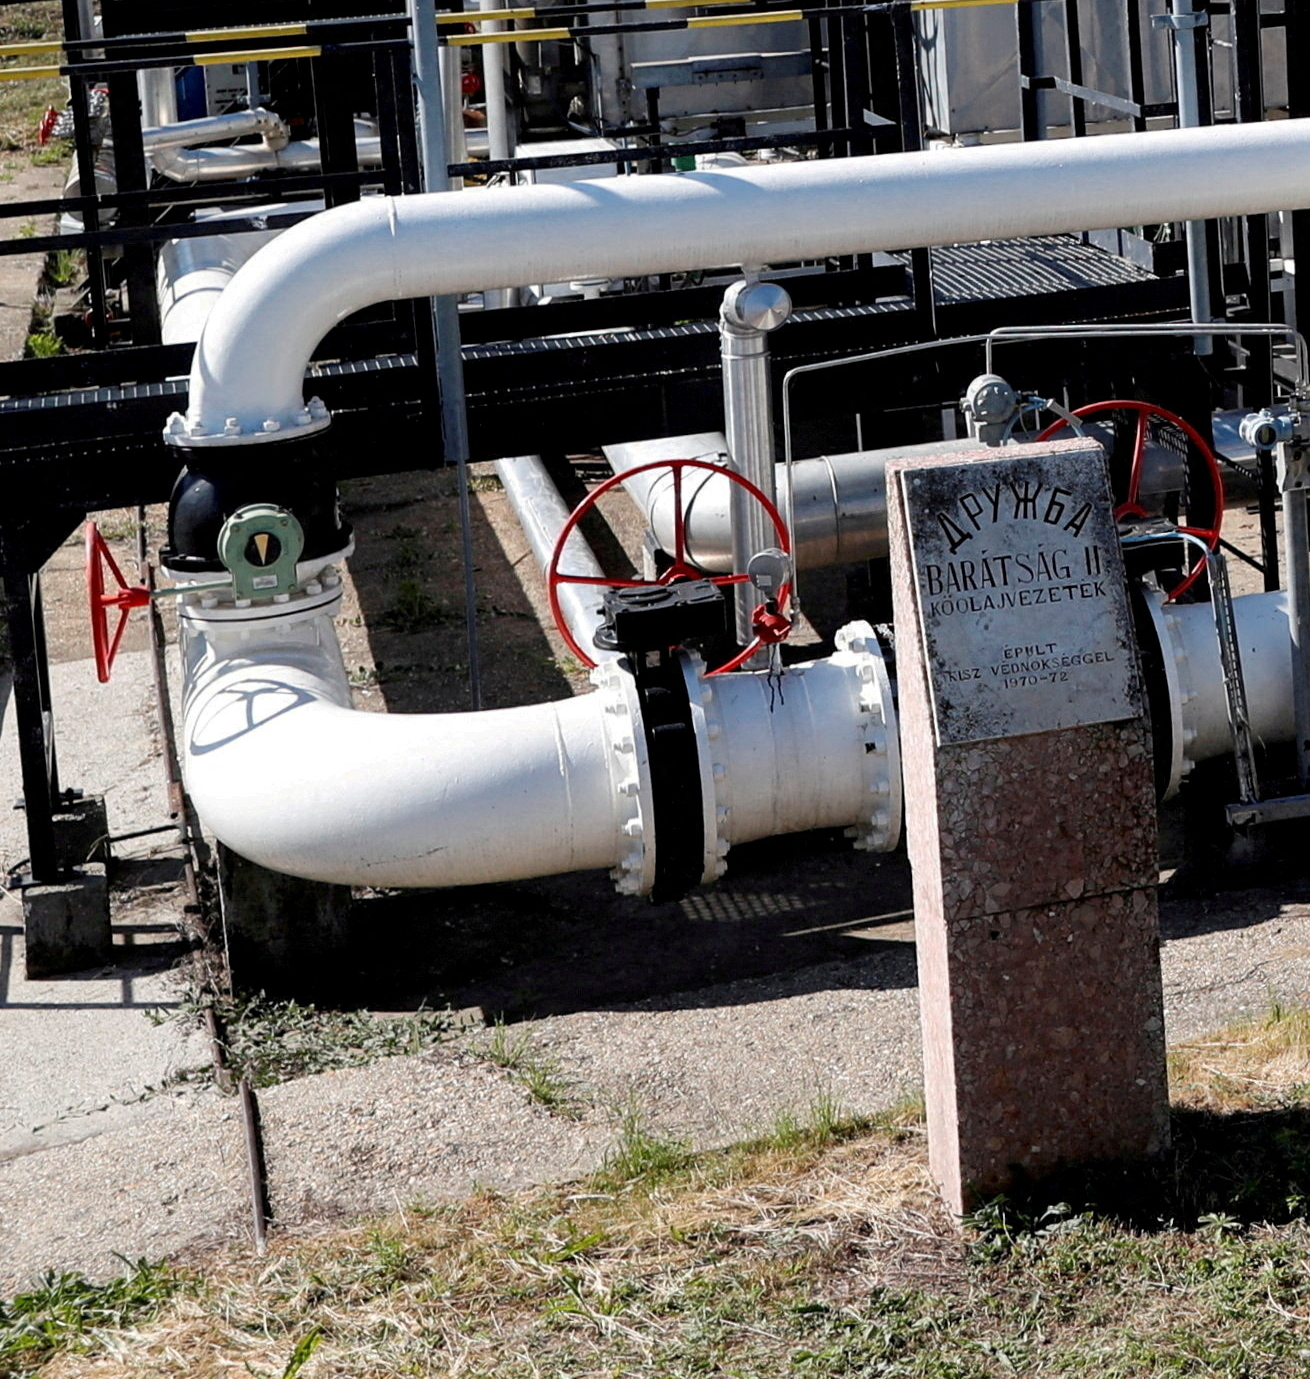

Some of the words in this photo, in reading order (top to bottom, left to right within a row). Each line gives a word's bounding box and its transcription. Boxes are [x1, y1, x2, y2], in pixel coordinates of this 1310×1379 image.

[936, 481, 1093, 555] ДРУЖБА
[926, 543, 1071, 596] BARÁTSÁG
[1003, 671, 1069, 689] 1970-72
